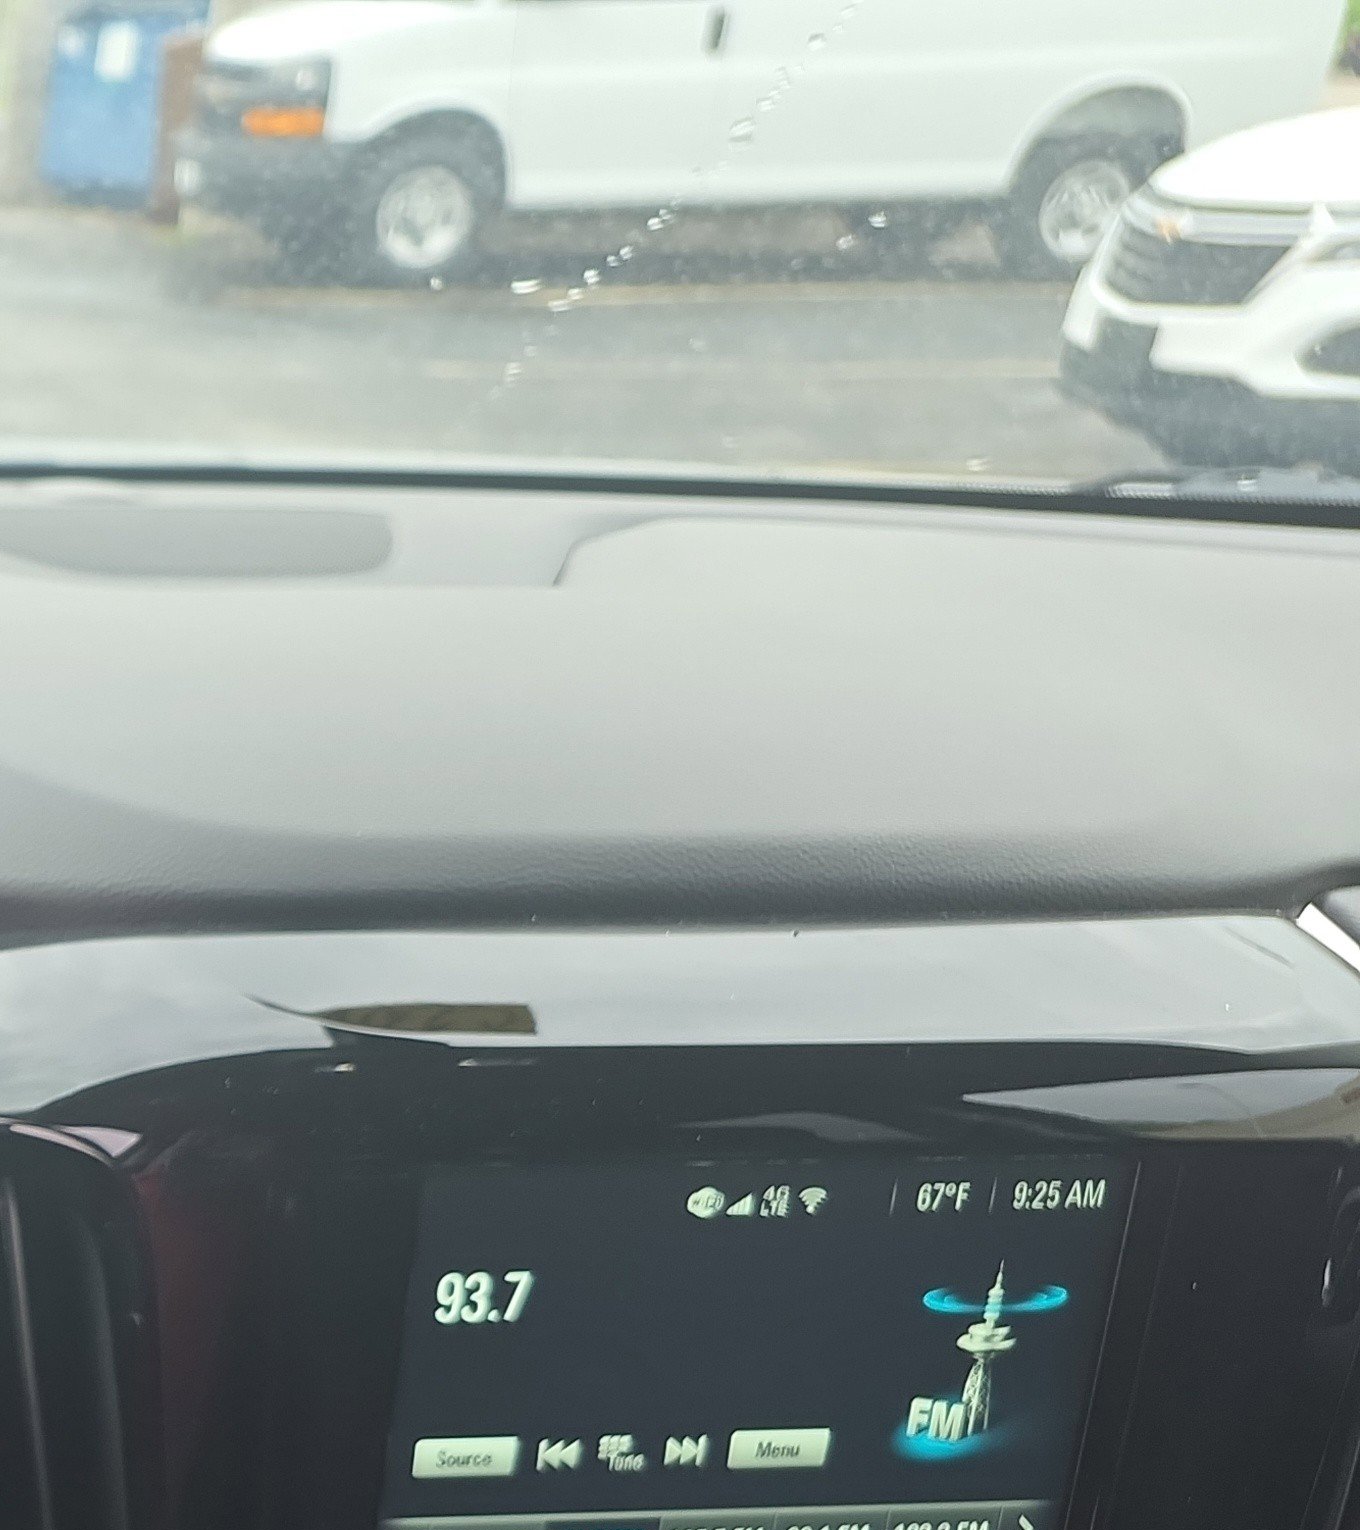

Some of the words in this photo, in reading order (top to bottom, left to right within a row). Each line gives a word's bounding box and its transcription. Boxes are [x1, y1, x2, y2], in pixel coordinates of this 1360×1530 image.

[1013, 1180, 1062, 1210] 9:25
[1065, 1179, 1106, 1209] AM
[435, 1270, 533, 1324] 93.7
[907, 1397, 968, 1441] FM
[436, 1451, 492, 1468] Source
[606, 1453, 646, 1472] Tune
[755, 1441, 800, 1459] Menu
